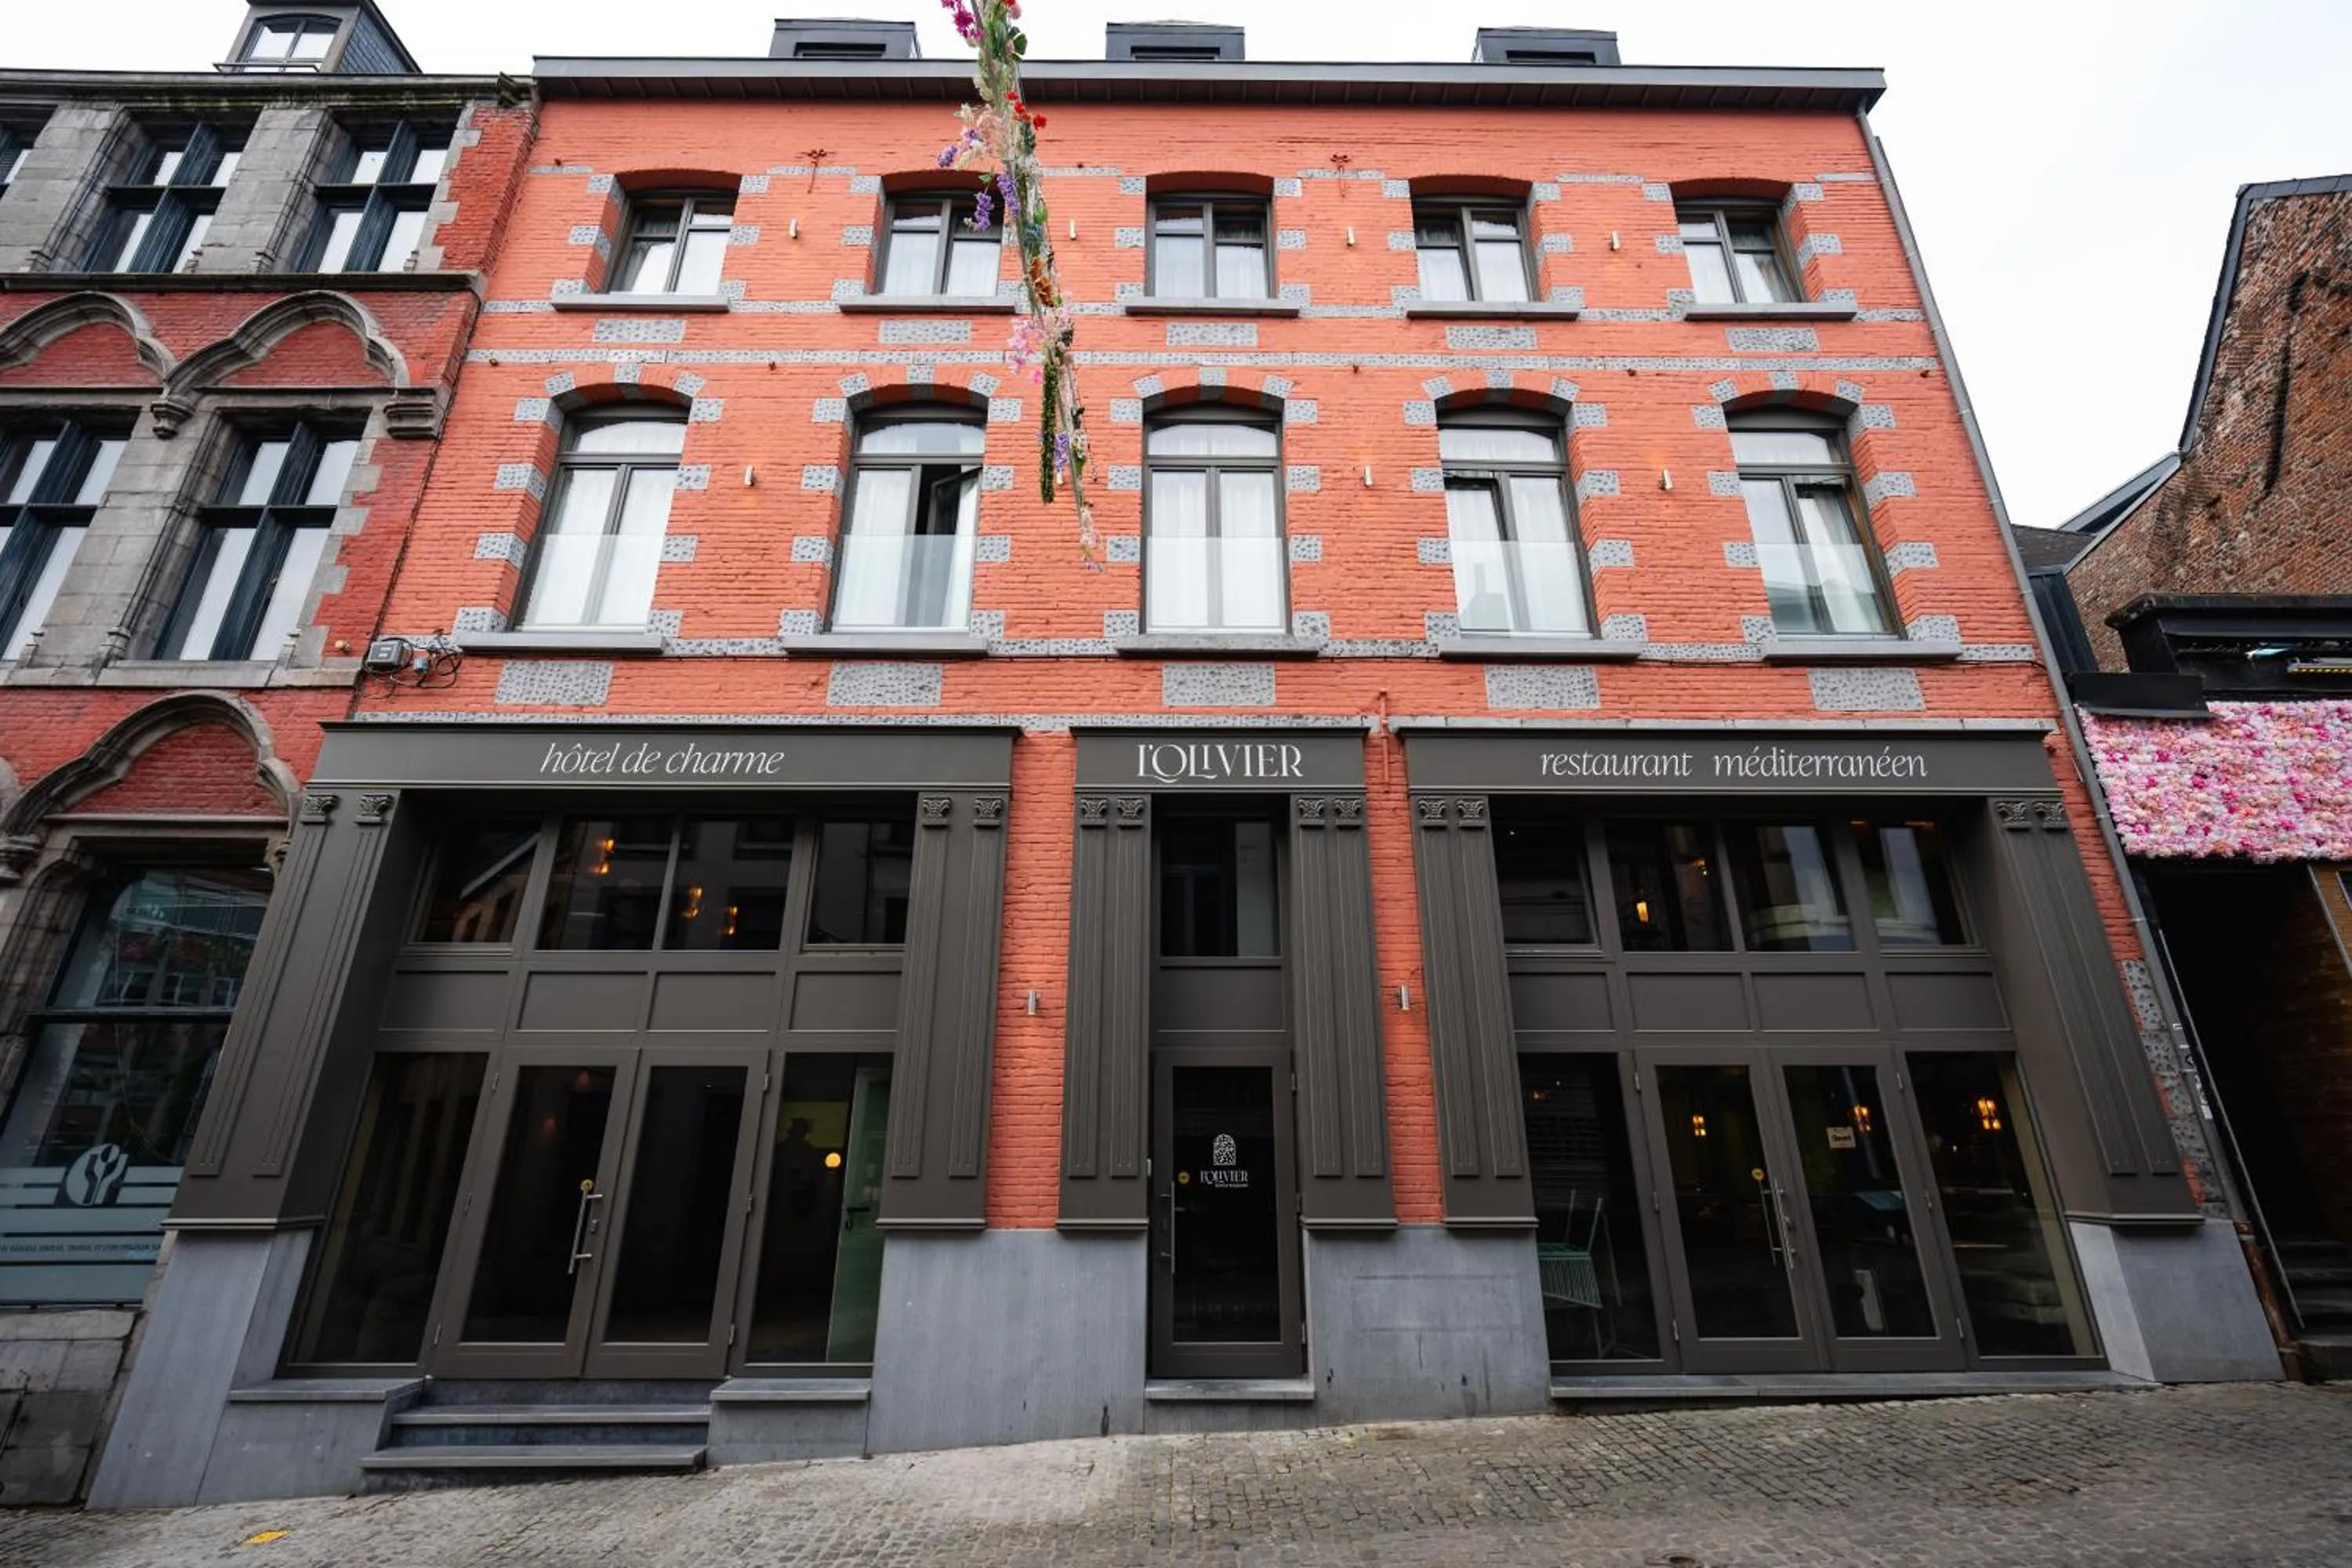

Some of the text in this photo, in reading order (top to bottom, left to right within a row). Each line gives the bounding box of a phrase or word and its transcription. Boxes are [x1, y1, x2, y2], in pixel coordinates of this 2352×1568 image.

[540, 742, 784, 775] hôtel de charme
[1138, 743, 1304, 783] L'OLIVIER
[1541, 746, 1928, 778] restaurant méditerranéen
